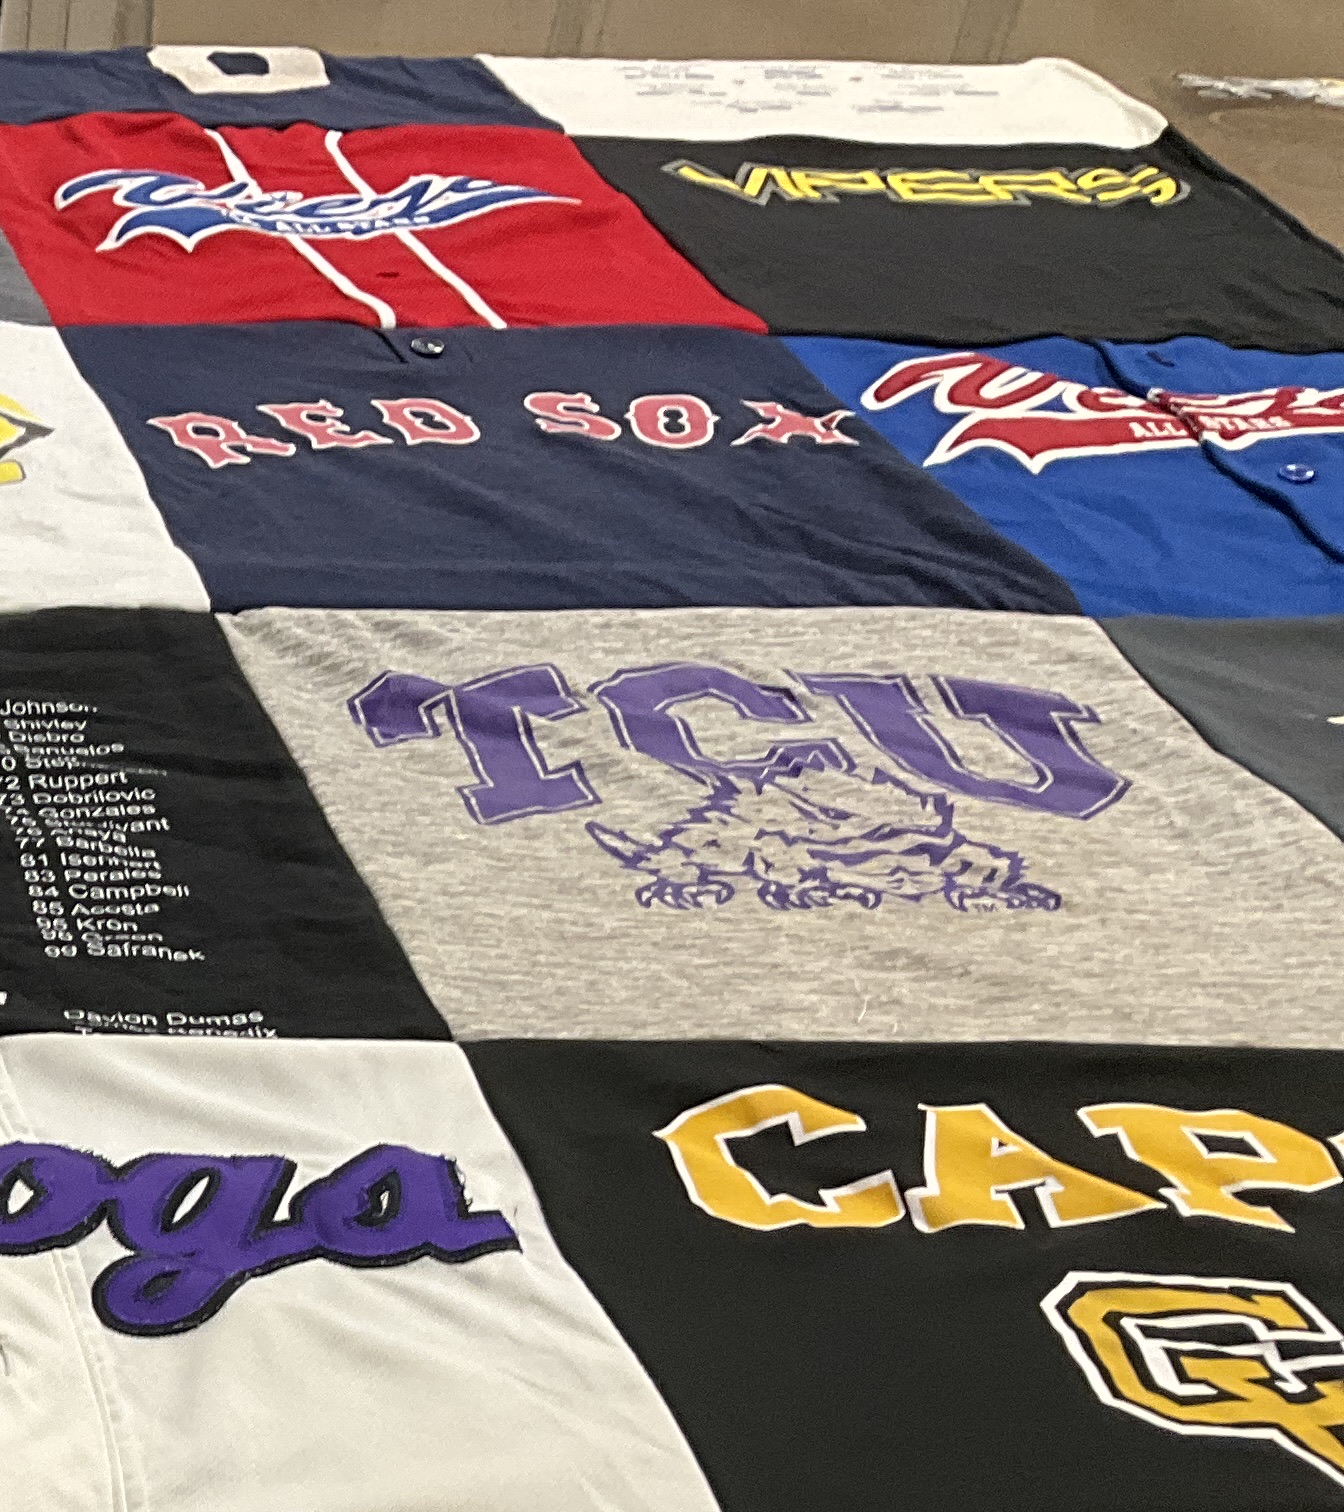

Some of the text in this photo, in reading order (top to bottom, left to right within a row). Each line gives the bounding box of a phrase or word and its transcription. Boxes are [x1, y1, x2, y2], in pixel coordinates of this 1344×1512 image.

[662, 159, 1190, 206] VIPERS
[147, 391, 859, 469] RED SOX
[1127, 418, 1188, 440] ALL
[348, 662, 1132, 825] TCU
[28, 770, 129, 791] Ruppert
[68, 882, 190, 902] Campbell
[76, 917, 138, 932] Kron
[166, 1010, 263, 1026] Dumas
[652, 1084, 1344, 1233] CAP
